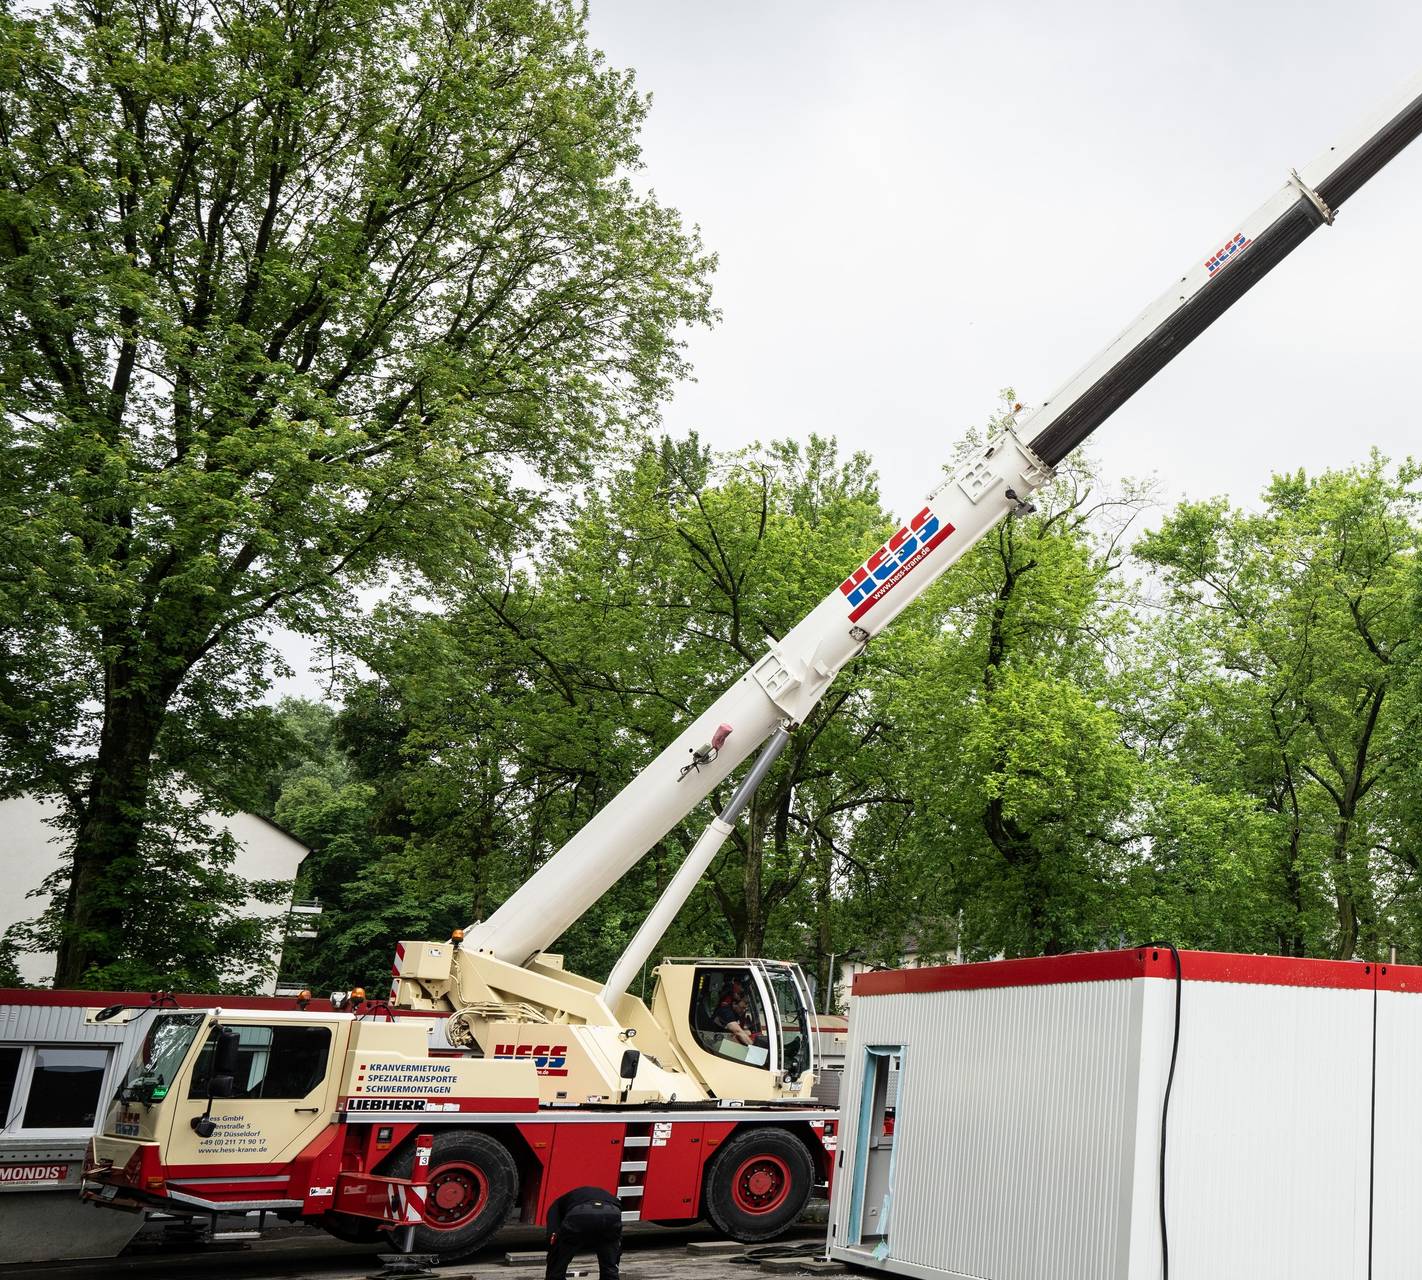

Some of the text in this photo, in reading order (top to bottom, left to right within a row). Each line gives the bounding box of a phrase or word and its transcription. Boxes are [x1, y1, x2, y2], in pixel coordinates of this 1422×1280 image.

[1204, 233, 1246, 272] HESS
[838, 506, 940, 608] HESS
[872, 545, 931, 601] www.hess-krane.de
[493, 1044, 568, 1068] HESS
[369, 1063, 451, 1073] KRANVERMIETUNG
[367, 1074, 457, 1083] SPEZIALTRANSPORTE
[365, 1084, 451, 1094] SCHWERMONTAGEN
[347, 1099, 426, 1111] LIEBHERR
[421, 1157, 428, 1165] 3
